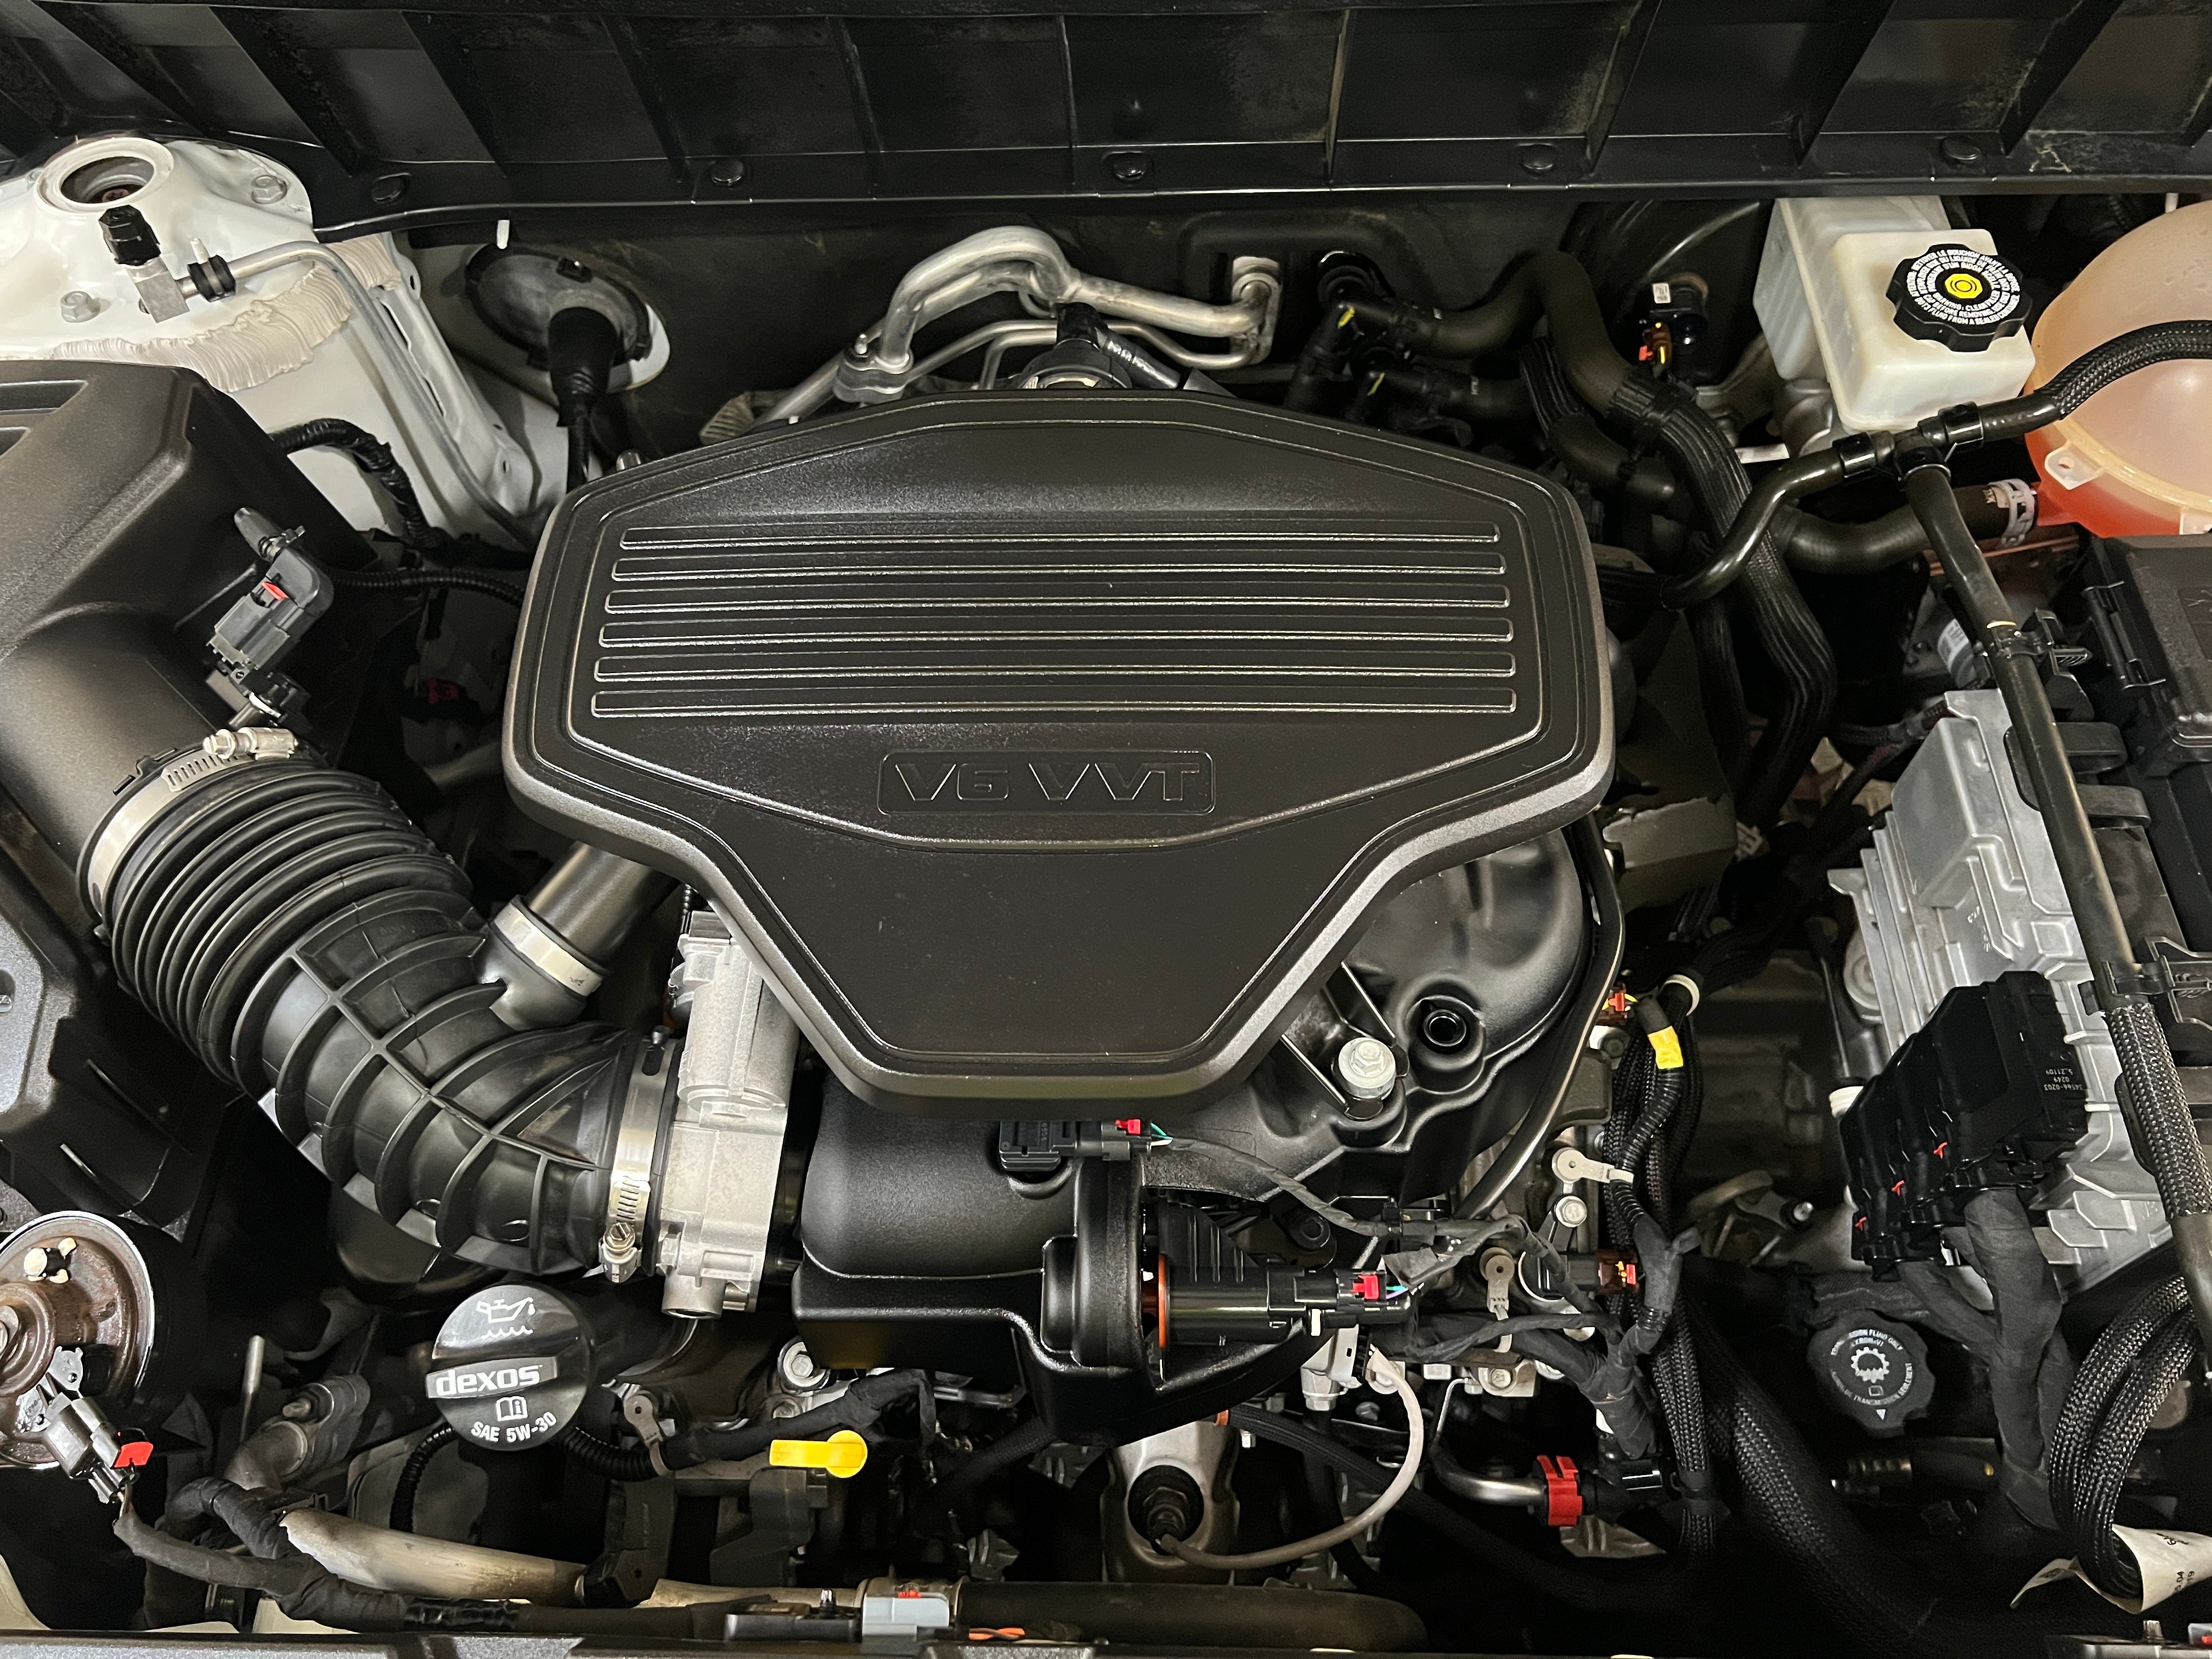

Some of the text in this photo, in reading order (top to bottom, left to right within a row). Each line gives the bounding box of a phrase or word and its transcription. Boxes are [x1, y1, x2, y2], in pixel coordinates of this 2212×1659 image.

[1946, 249, 1980, 258] BOUCHON
[1978, 255, 2002, 268] AVANT
[1997, 266, 2009, 275] LA
[1949, 255, 1977, 264] LIQUIDE
[1961, 262, 1984, 273] BIDON
[1923, 294, 1936, 303] CAP
[1932, 301, 1959, 317] BEFORE
[1927, 307, 1949, 320] FLUID
[1947, 315, 1968, 325] FROM
[1965, 302, 1989, 312] CLEAN
[895, 763, 1200, 802] V6 VVT
[436, 1364, 540, 1396] dexos
[471, 1411, 557, 1443] SAE 5W-30
